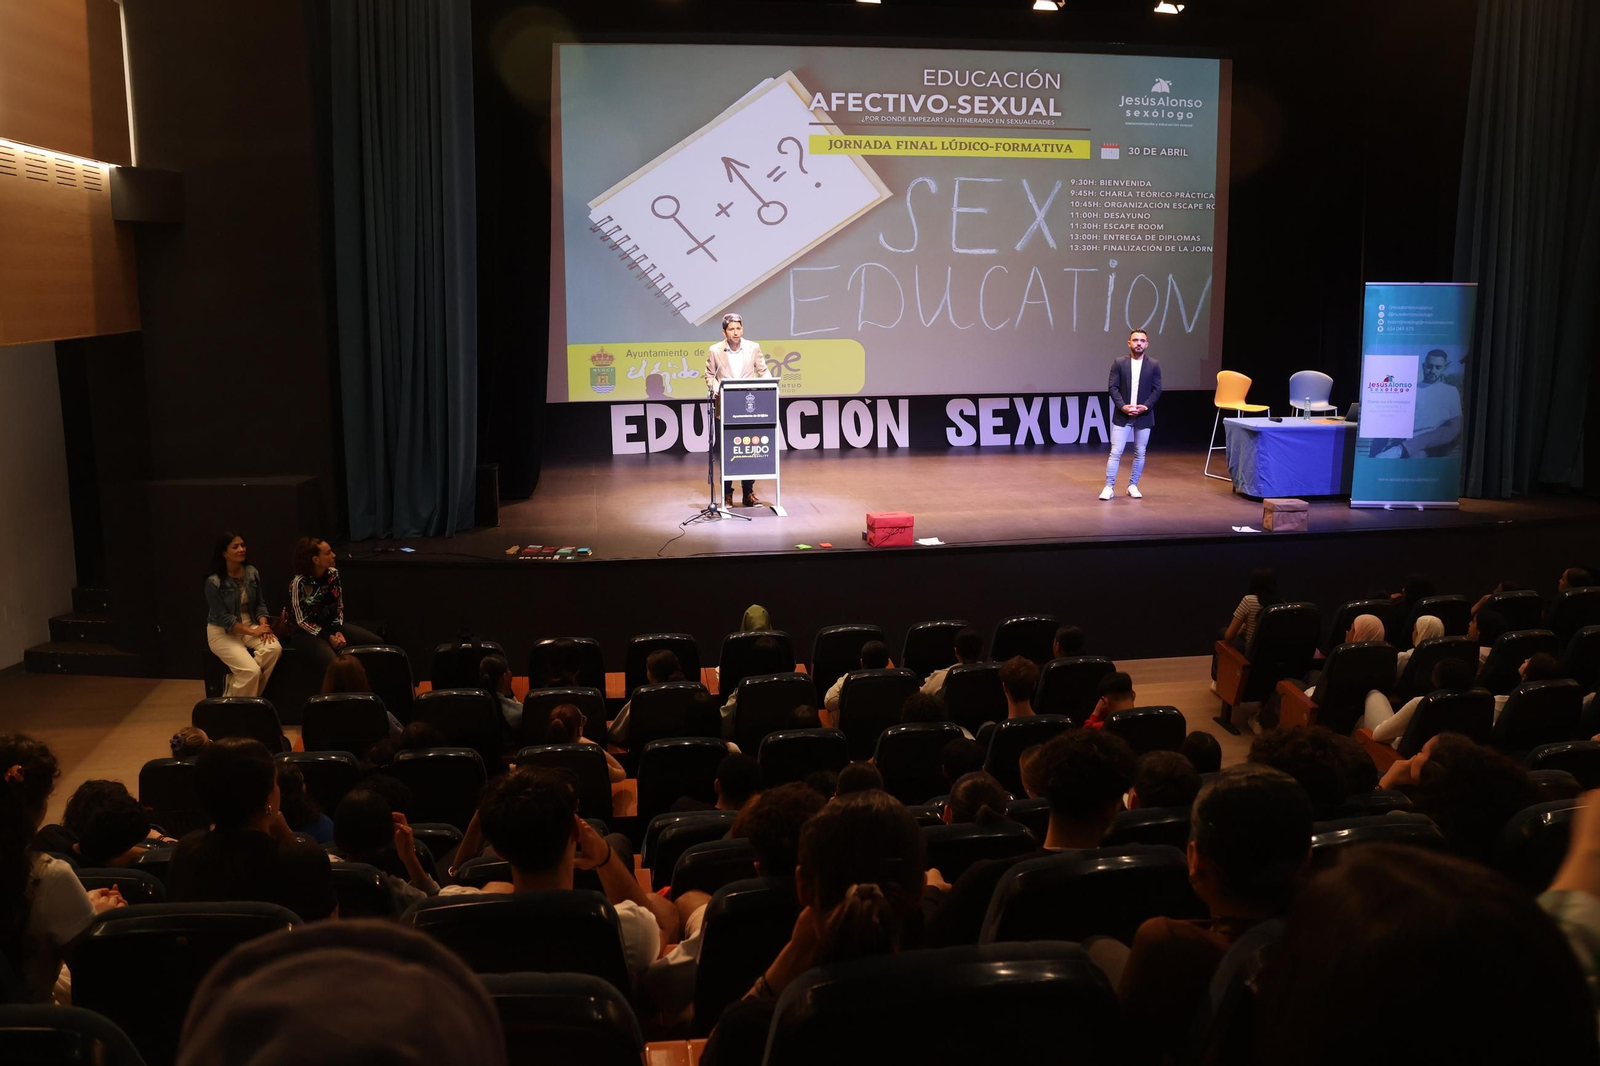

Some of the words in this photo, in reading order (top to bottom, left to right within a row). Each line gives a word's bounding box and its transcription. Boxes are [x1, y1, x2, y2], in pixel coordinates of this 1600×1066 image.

[923, 69, 1061, 89] EDUCACIÓN
[809, 92, 1062, 117] AFECTIVO-SEXUAL
[1119, 95, 1203, 108] JesúsAlonso
[1125, 109, 1194, 120] sexólogo
[828, 139, 892, 151] JORNADA
[896, 140, 938, 151] FINAL
[941, 139, 1073, 154] LÚDICO-FORMATIVA
[1128, 147, 1140, 155] 30
[1143, 147, 1157, 156] DE
[1160, 148, 1188, 157] ABRIL
[1136, 190, 1214, 199] TEÓRICO-PRÁCTICA
[1104, 200, 1170, 209] ORGANIZACIÓN
[878, 176, 1063, 254] SEX
[1103, 244, 1162, 252] FINALIZACIÓN
[626, 349, 689, 359] Ayuntamiento
[610, 398, 910, 455] EDUCIÓN
[945, 396, 1135, 447] SEXUA
[733, 446, 744, 454] EL
[745, 445, 769, 454] EJIDO
